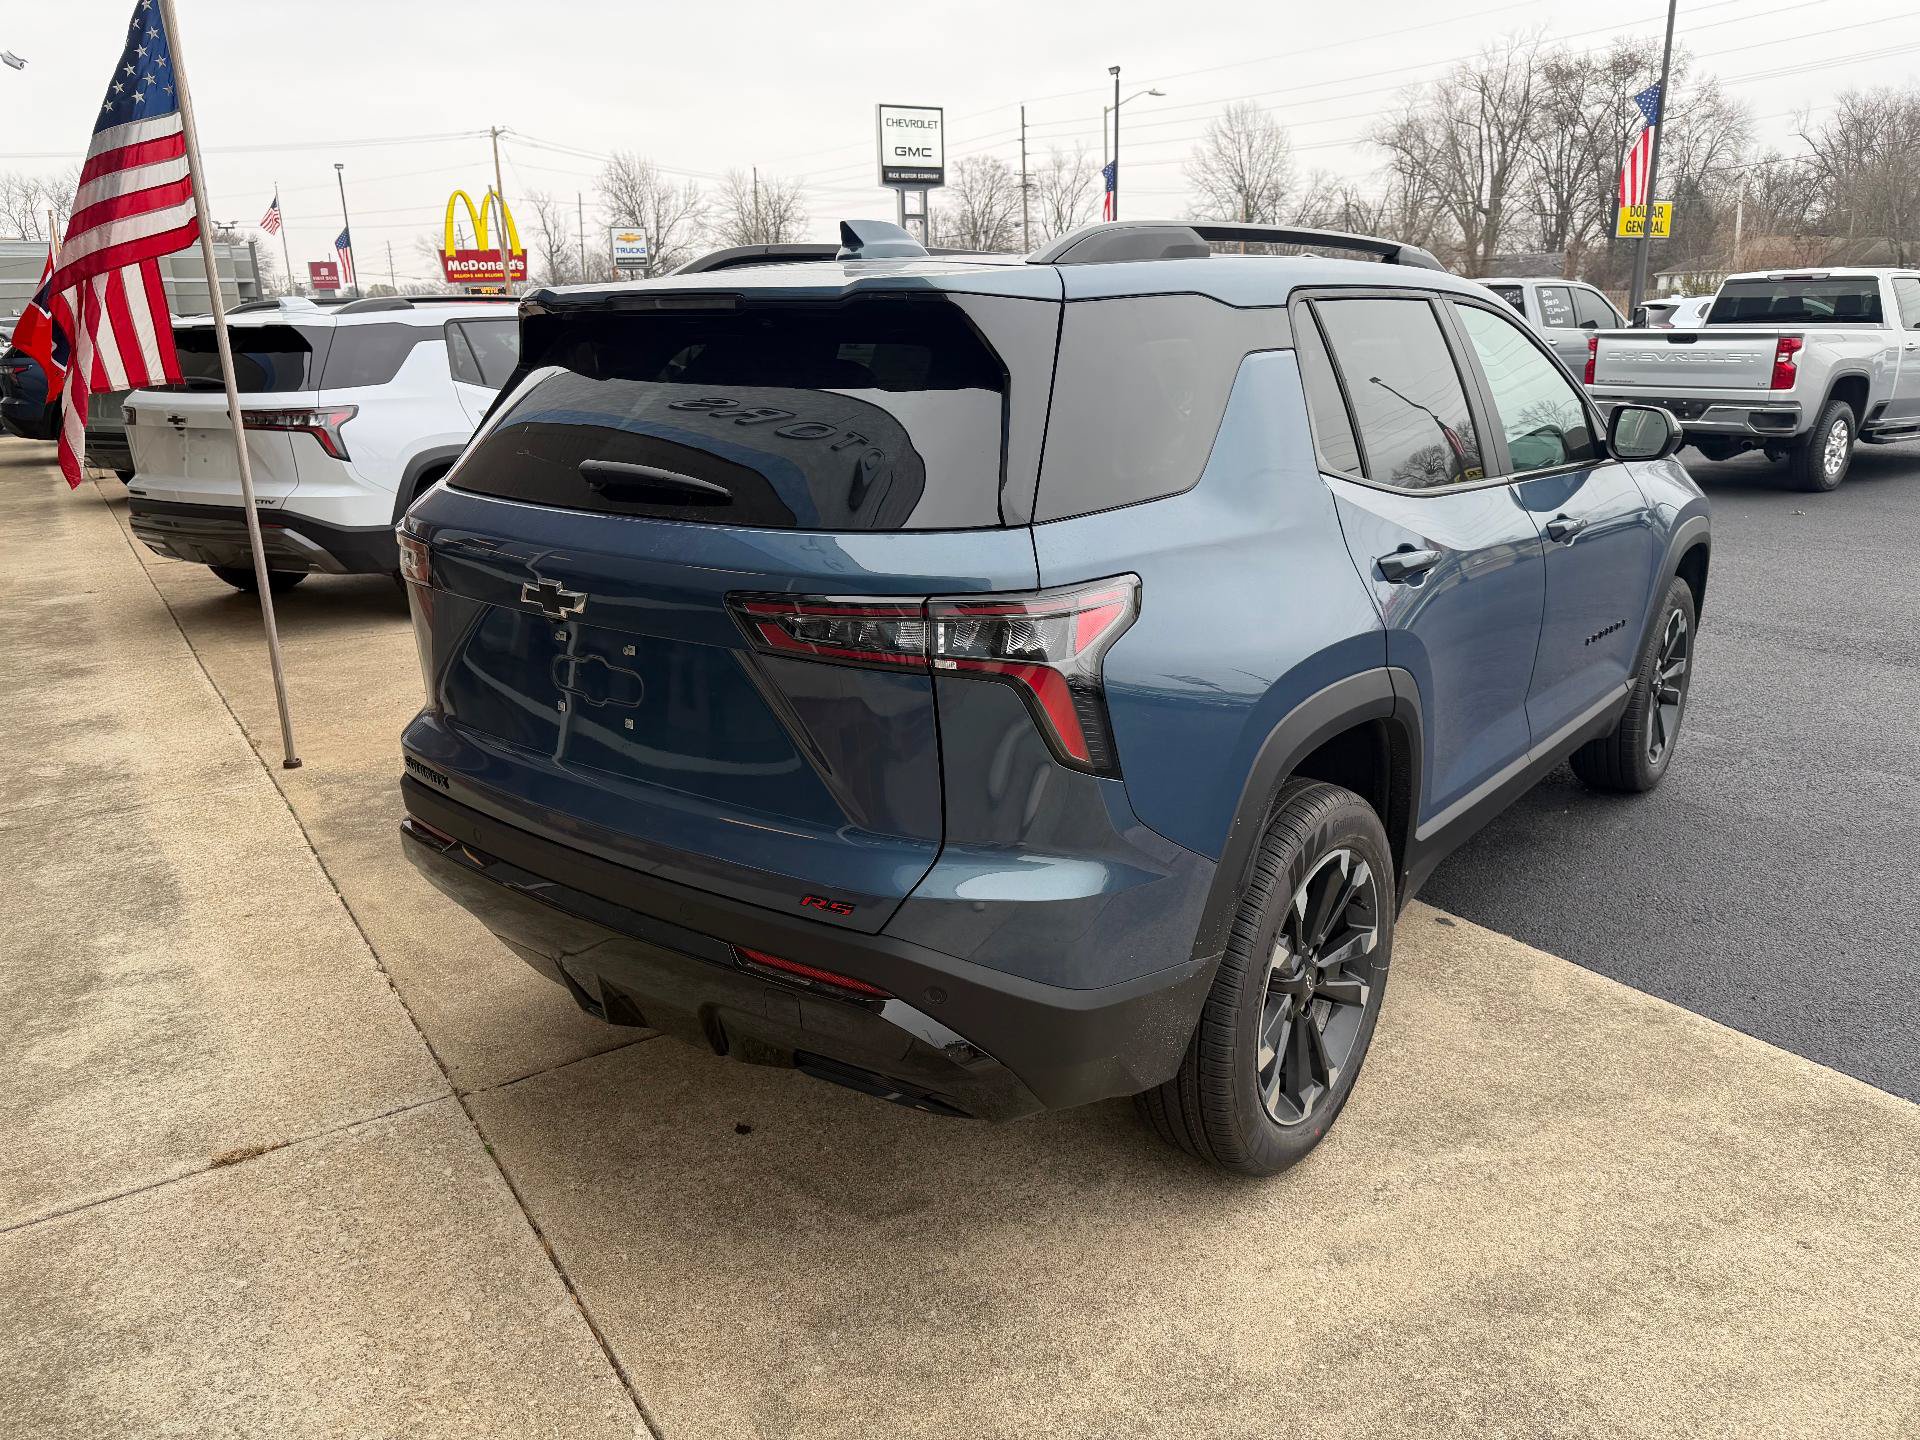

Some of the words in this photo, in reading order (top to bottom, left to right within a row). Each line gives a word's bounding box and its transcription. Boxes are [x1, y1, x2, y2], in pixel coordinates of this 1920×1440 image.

[886, 118, 938, 129] CHEVROLET
[895, 146, 932, 157] GMC
[1630, 205, 1664, 218] DOLAR
[1626, 220, 1664, 233] GENAL
[447, 259, 525, 271] McDonad's
[1605, 351, 1762, 363] CHEVROLET
[799, 893, 857, 916] RS
